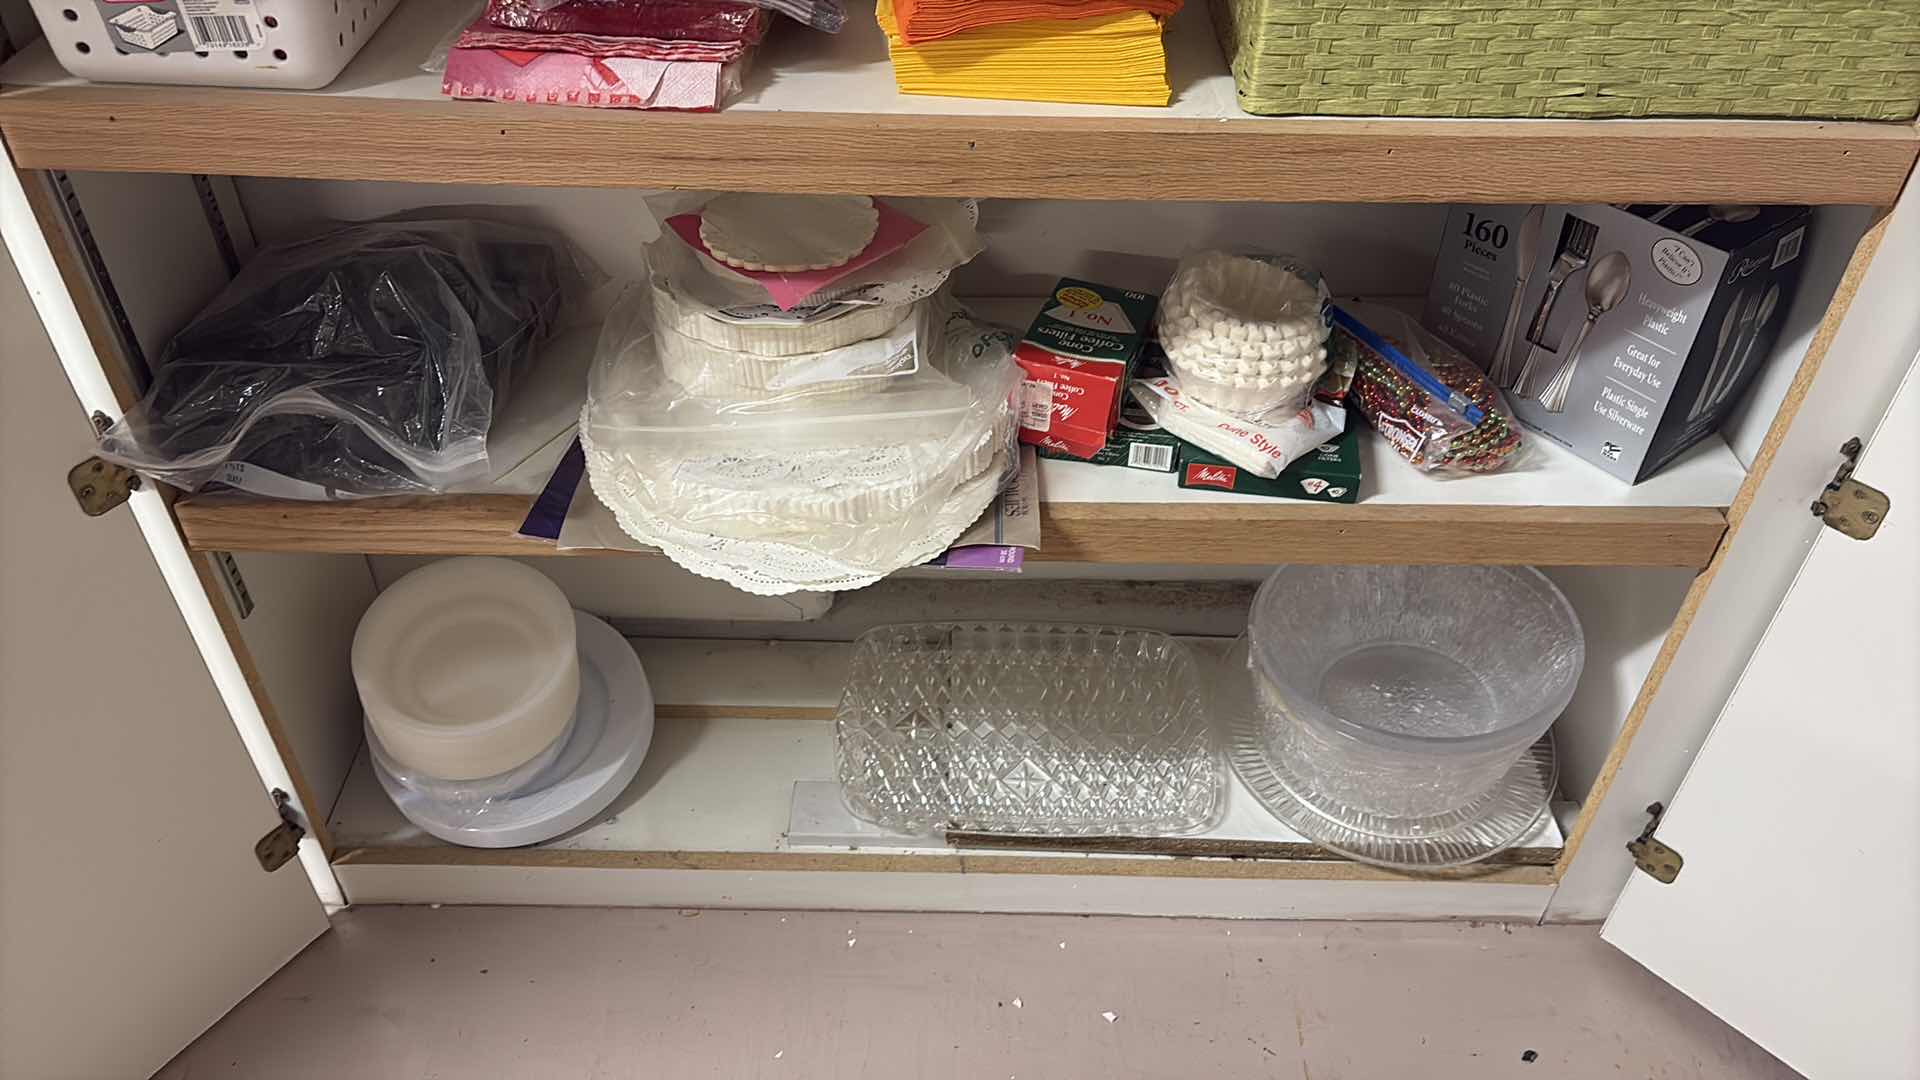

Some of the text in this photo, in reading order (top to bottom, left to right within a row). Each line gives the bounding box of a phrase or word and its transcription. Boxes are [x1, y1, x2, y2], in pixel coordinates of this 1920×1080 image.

[1463, 212, 1508, 249] 160
[1464, 239, 1497, 261] Pieces
[1639, 291, 1688, 325] Heavyweight
[1038, 327, 1077, 343] Filters
[1643, 314, 1671, 336] Plastic
[1059, 340, 1094, 353] Cone
[1079, 333, 1125, 351] Coffee
[1627, 344, 1661, 369] Great for
[1614, 356, 1662, 389] Everyday Use
[1059, 382, 1085, 396] Coffee
[1601, 386, 1649, 419] Plastic Single
[1593, 400, 1645, 436] Use Silverware
[1250, 433, 1281, 459] Style
[1193, 466, 1232, 482] Melitta
